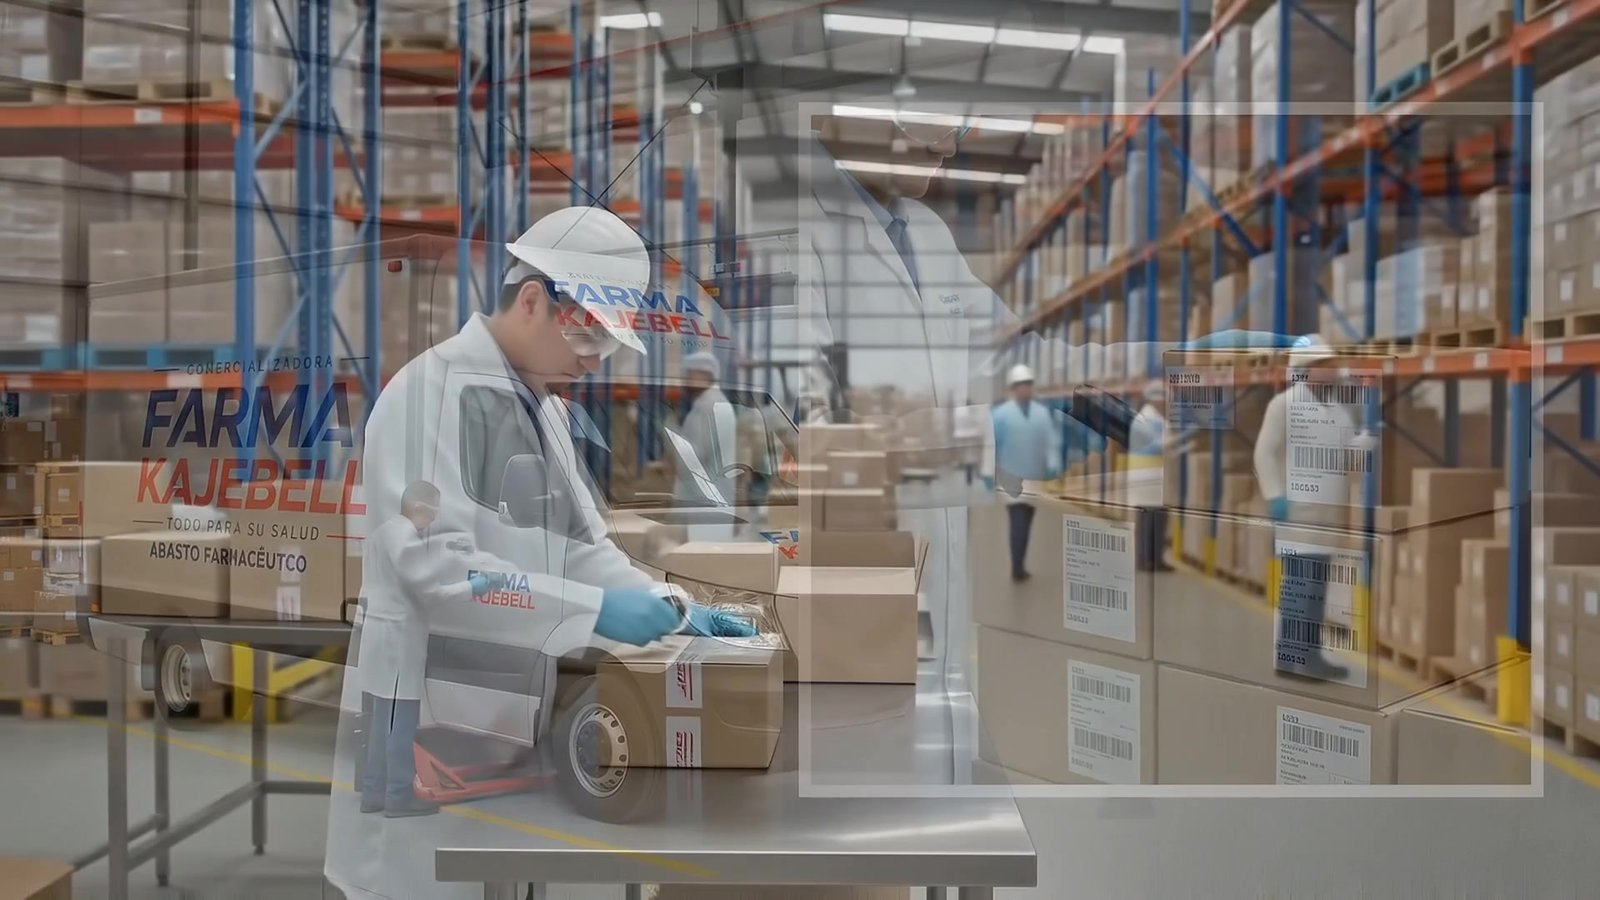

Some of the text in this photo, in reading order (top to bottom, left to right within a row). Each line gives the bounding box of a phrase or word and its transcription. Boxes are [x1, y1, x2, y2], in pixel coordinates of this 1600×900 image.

[547, 279, 704, 318] FARMA
[555, 305, 731, 341] KAJEBELL
[142, 382, 354, 448] FARMA
[137, 458, 367, 515] KAJEBELL
[166, 517, 320, 541] TODO PARA SU SALUD
[149, 541, 200, 562] ABASTO
